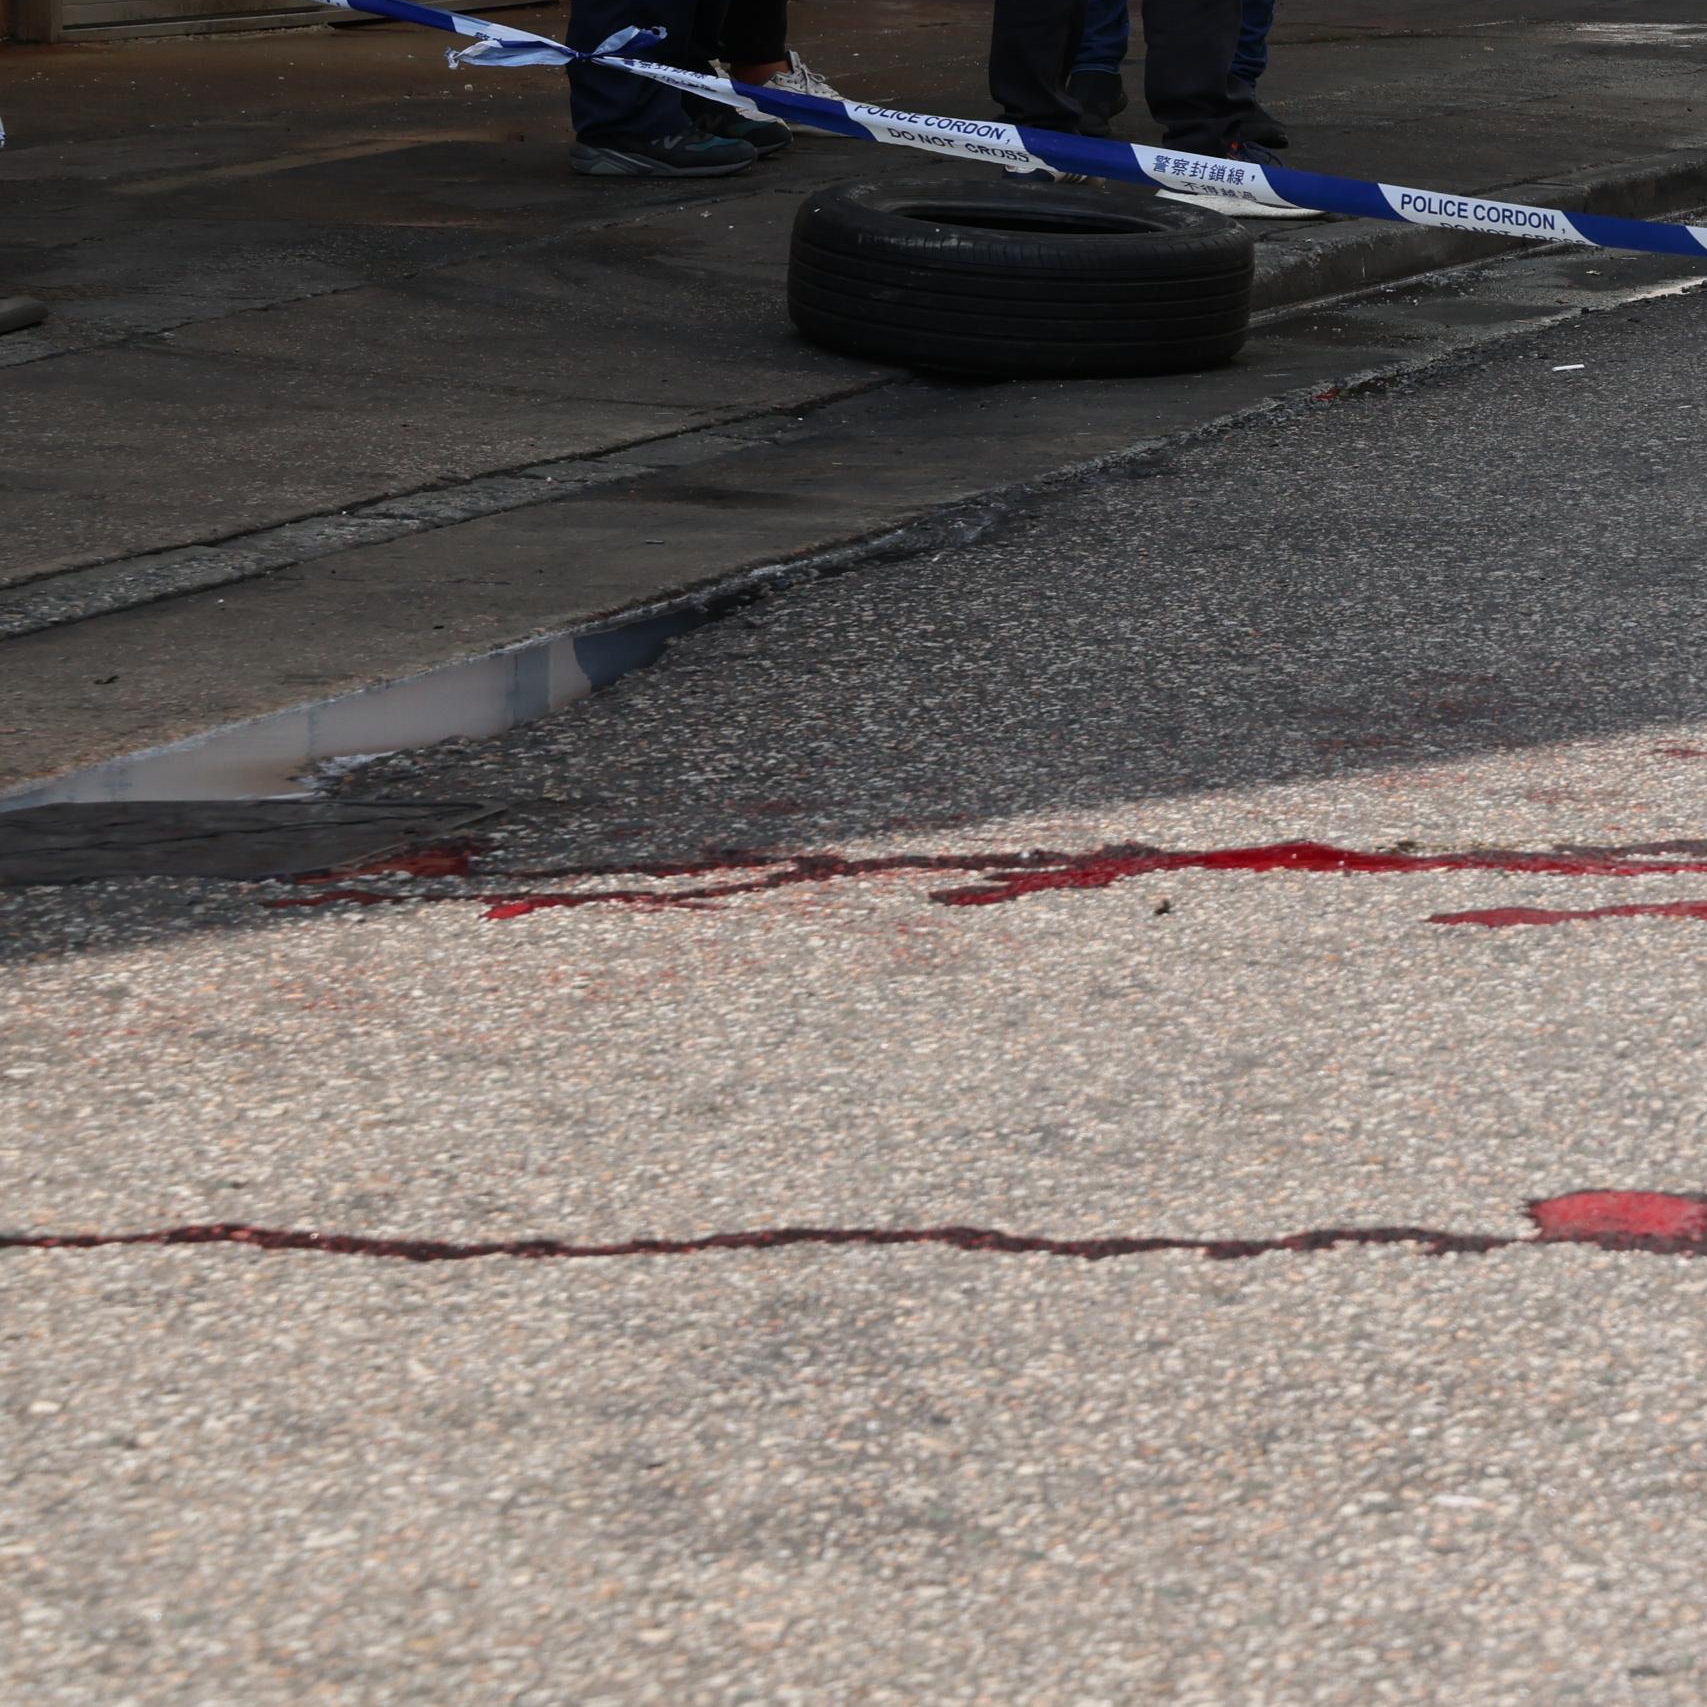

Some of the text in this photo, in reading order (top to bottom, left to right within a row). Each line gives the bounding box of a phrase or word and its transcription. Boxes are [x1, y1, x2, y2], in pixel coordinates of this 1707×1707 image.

[888, 128, 1029, 162] DO NOT CROSS
[1401, 194, 1468, 219] POLICE
